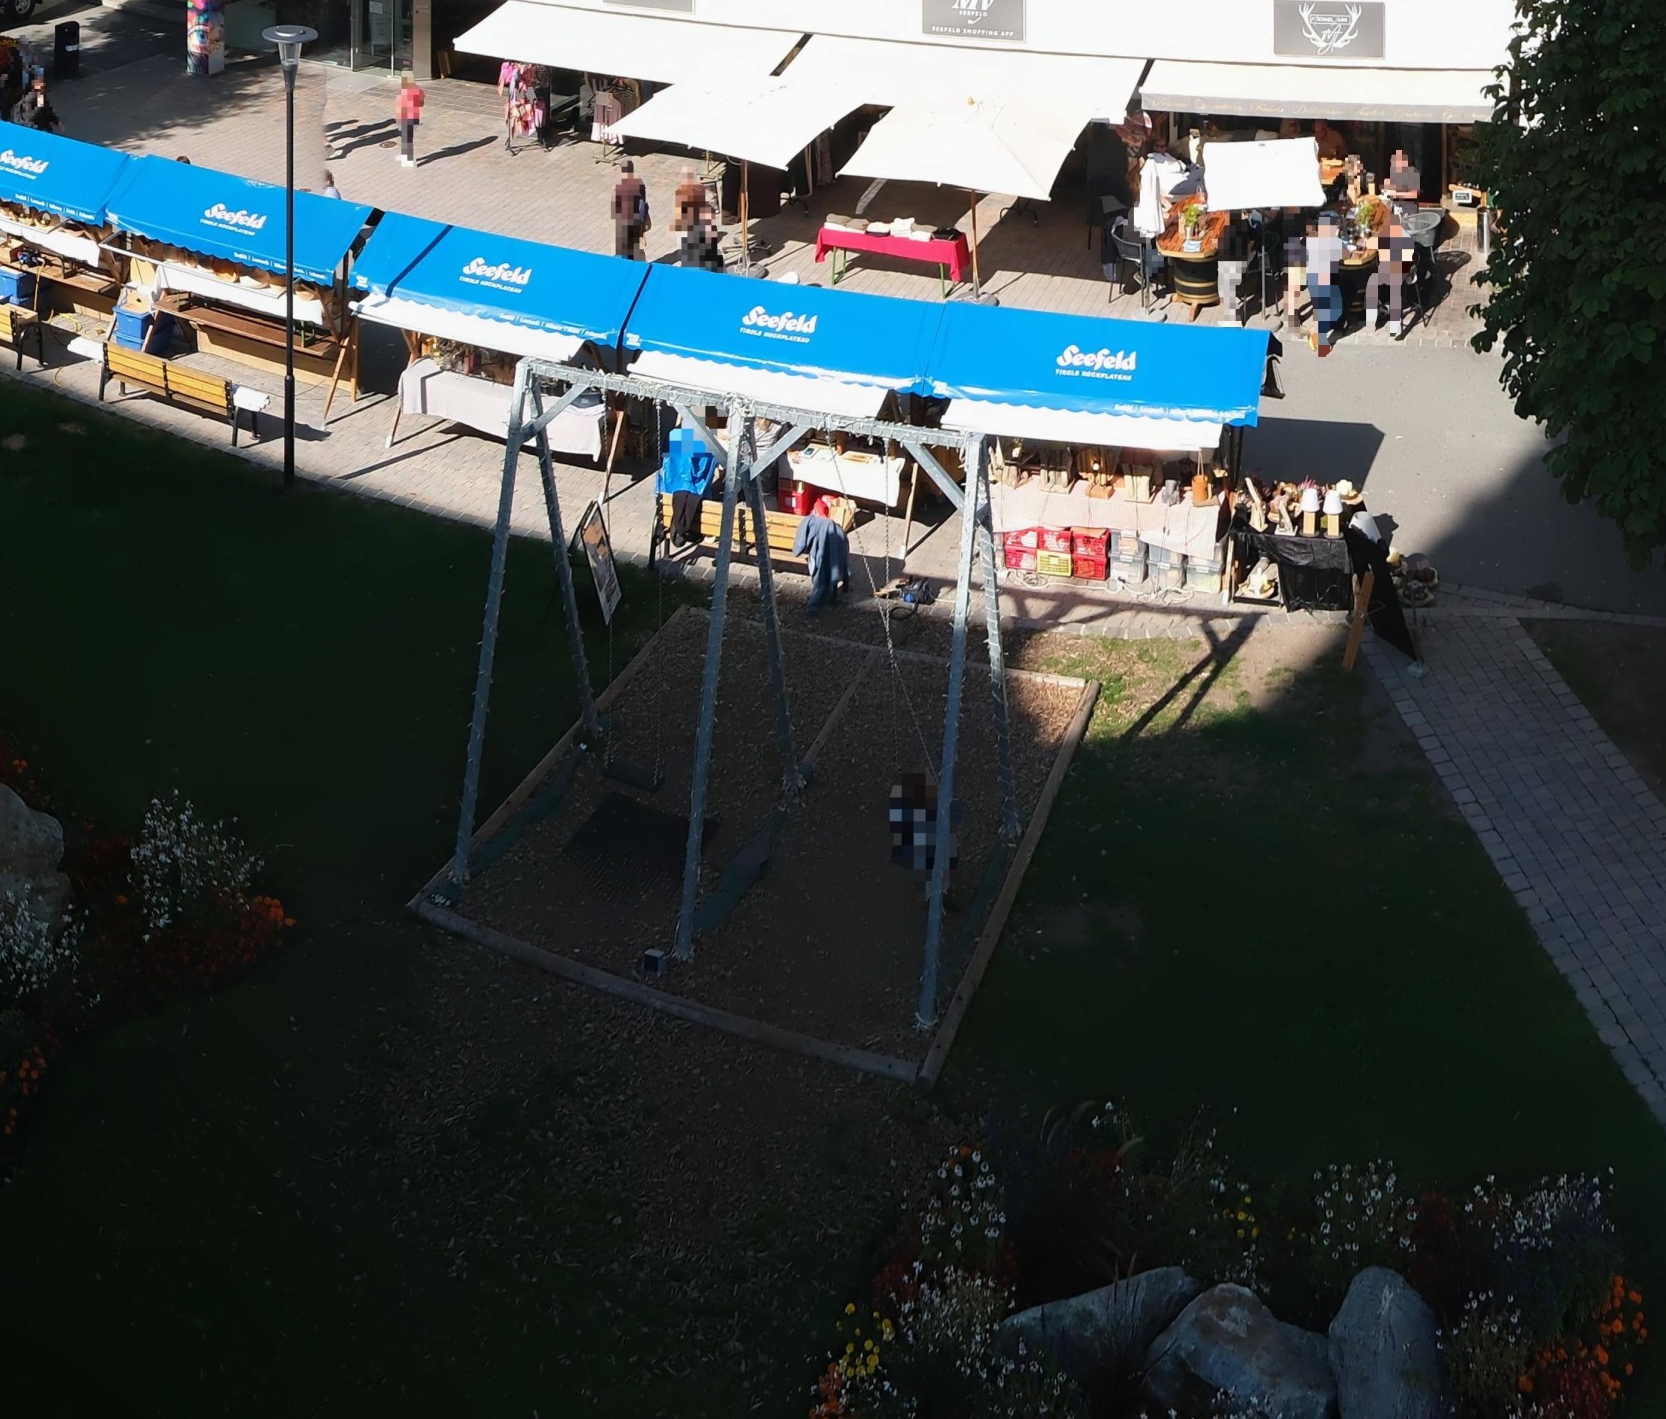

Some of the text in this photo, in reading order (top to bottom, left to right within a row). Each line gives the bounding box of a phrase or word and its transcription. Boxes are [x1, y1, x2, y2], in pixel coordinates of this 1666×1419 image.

[204, 202, 267, 229] Seefeld
[462, 256, 533, 285] Seefeld
[741, 305, 819, 335] Seefeld
[1055, 344, 1137, 371] Seefeld
